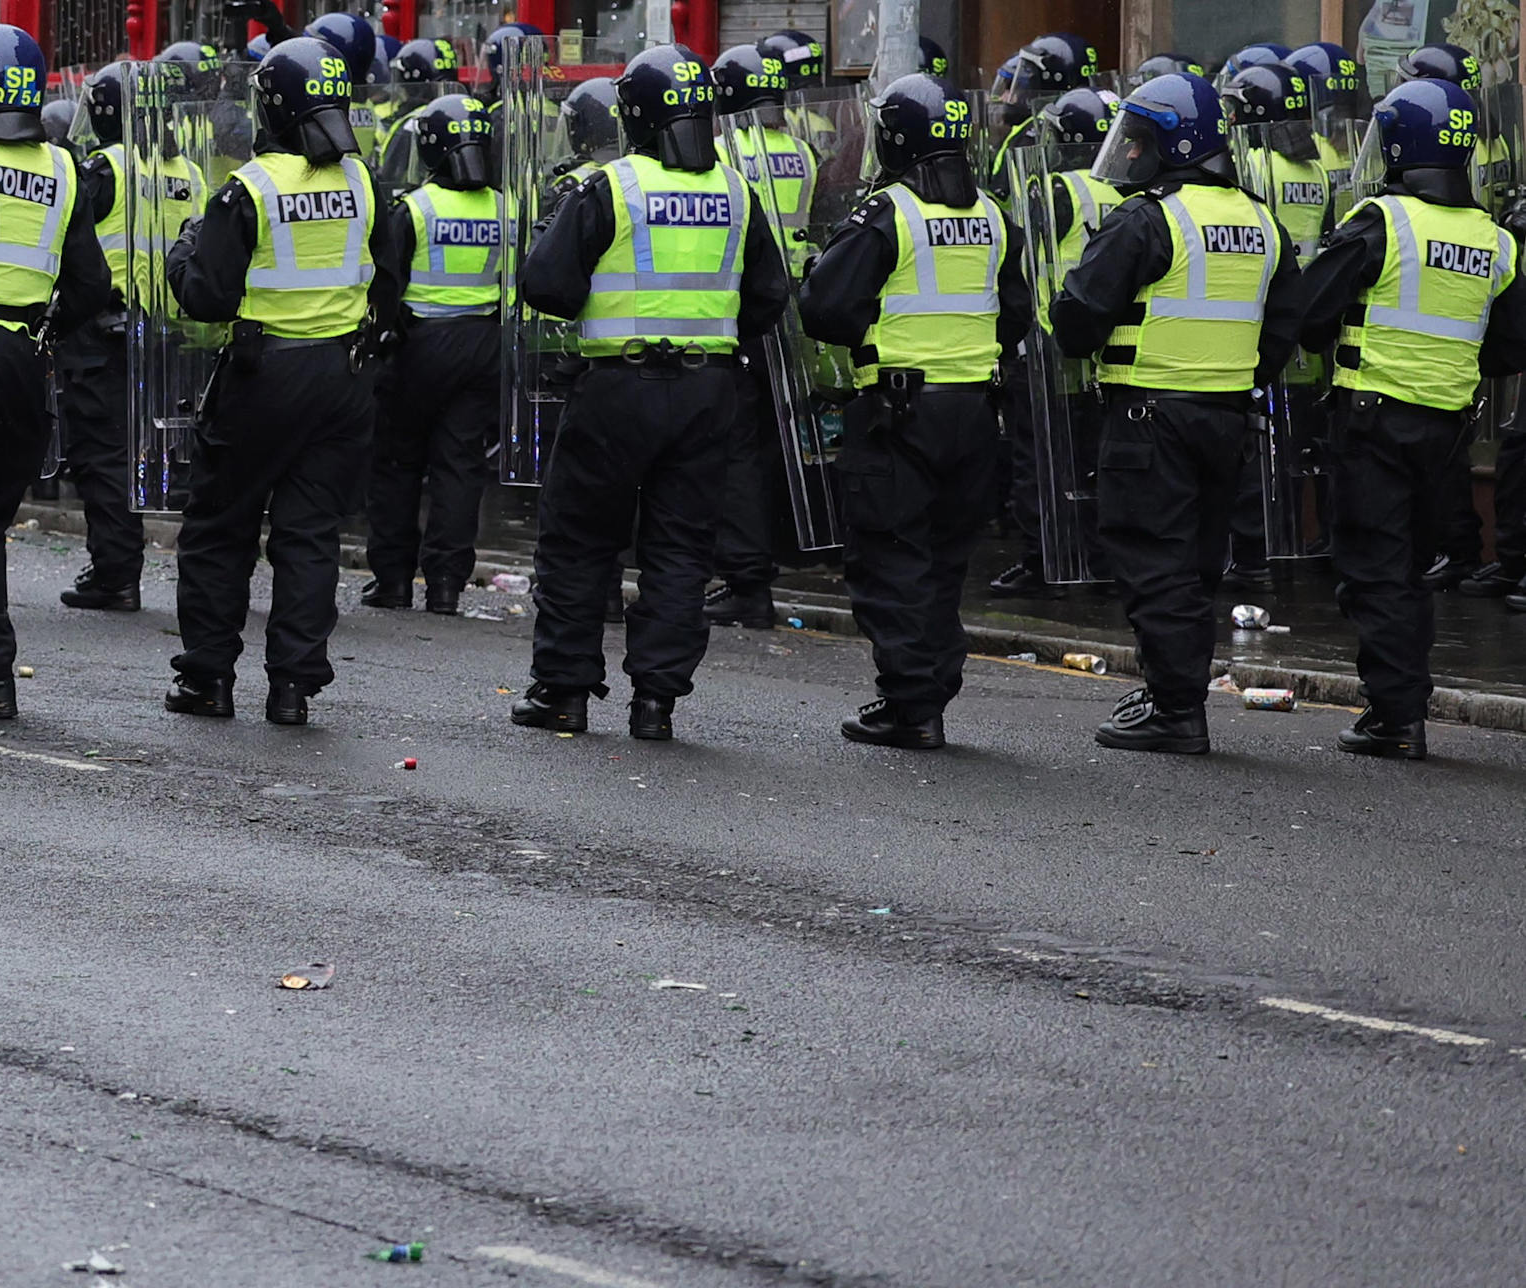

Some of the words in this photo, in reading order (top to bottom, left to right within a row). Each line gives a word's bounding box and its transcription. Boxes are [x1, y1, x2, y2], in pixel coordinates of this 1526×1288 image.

[320, 57, 345, 78] SP
[673, 61, 702, 81] SP
[762, 59, 783, 74] SP
[1339, 60, 1357, 77] SP
[5, 67, 36, 89] SP
[746, 74, 788, 90] G293
[461, 98, 485, 112] SP
[663, 87, 714, 106] Q756
[349, 108, 374, 127] OLICE
[945, 101, 968, 122] SP
[1449, 109, 1473, 130] SP
[448, 121, 495, 134] G337
[1438, 130, 1478, 148] S667
[1284, 183, 1323, 205] POLICE
[283, 191, 356, 222] POLICE
[648, 196, 729, 224] POLICE
[437, 220, 499, 245] POLICE
[929, 218, 991, 246] POLICE
[1205, 226, 1264, 254] POLICE
[1430, 242, 1490, 277] POLICE
